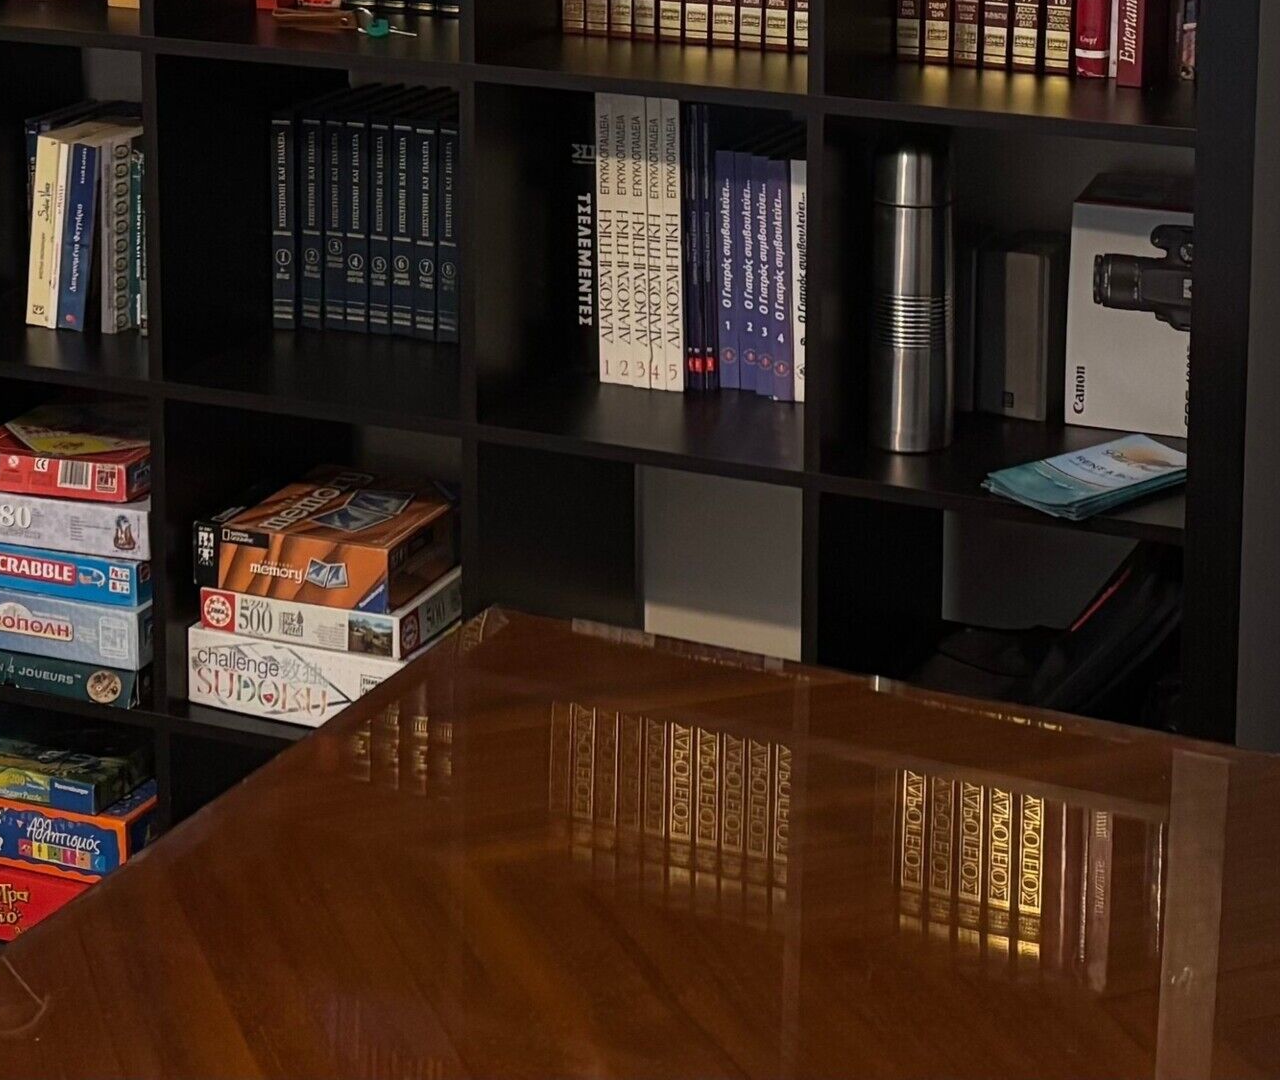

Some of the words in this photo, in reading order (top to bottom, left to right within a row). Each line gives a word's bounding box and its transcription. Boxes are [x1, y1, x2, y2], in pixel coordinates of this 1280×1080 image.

[577, 193, 592, 325] ΤΣΕΛΕΜΕΝΤΕΣ
[599, 210, 614, 344] ΔΙΑΚΟΣΜΗΤΙΚΗ
[617, 211, 630, 345] ΔΙΑΚΟΣΜΗΤΙΚΗ
[633, 212, 647, 346] ΔΙΑΚΟΣΜΗΤΙΚΗ
[649, 214, 662, 349] ΔΙΑΚΟΣΜΗΤΙΚΗ
[666, 214, 680, 349] ΔΙΑΚΟΣΜΗΤΙΚΗ
[721, 258, 733, 298] Γιατρός
[743, 258, 754, 298] Γιατρός
[758, 263, 769, 304] Γιατρός
[774, 270, 786, 310] Γιατρός
[722, 298, 731, 308] Ο
[745, 300, 753, 309] Ο
[759, 305, 768, 314] Ο
[775, 312, 784, 321] Ο
[726, 321, 730, 330] 1
[747, 323, 753, 331] 2
[762, 327, 767, 337] 3
[777, 333, 784, 343] 4
[604, 360, 609, 375] 1
[620, 361, 629, 376] 2
[636, 361, 645, 376] 3
[651, 363, 660, 380] 4
[669, 364, 677, 380] 5
[1073, 365, 1085, 414] Canon
[250, 562, 303, 584] memory
[239, 607, 273, 634] 500
[197, 646, 280, 678] challenge
[196, 667, 327, 717] SUDOKU
[26, 817, 101, 855] Αθλητισμός
